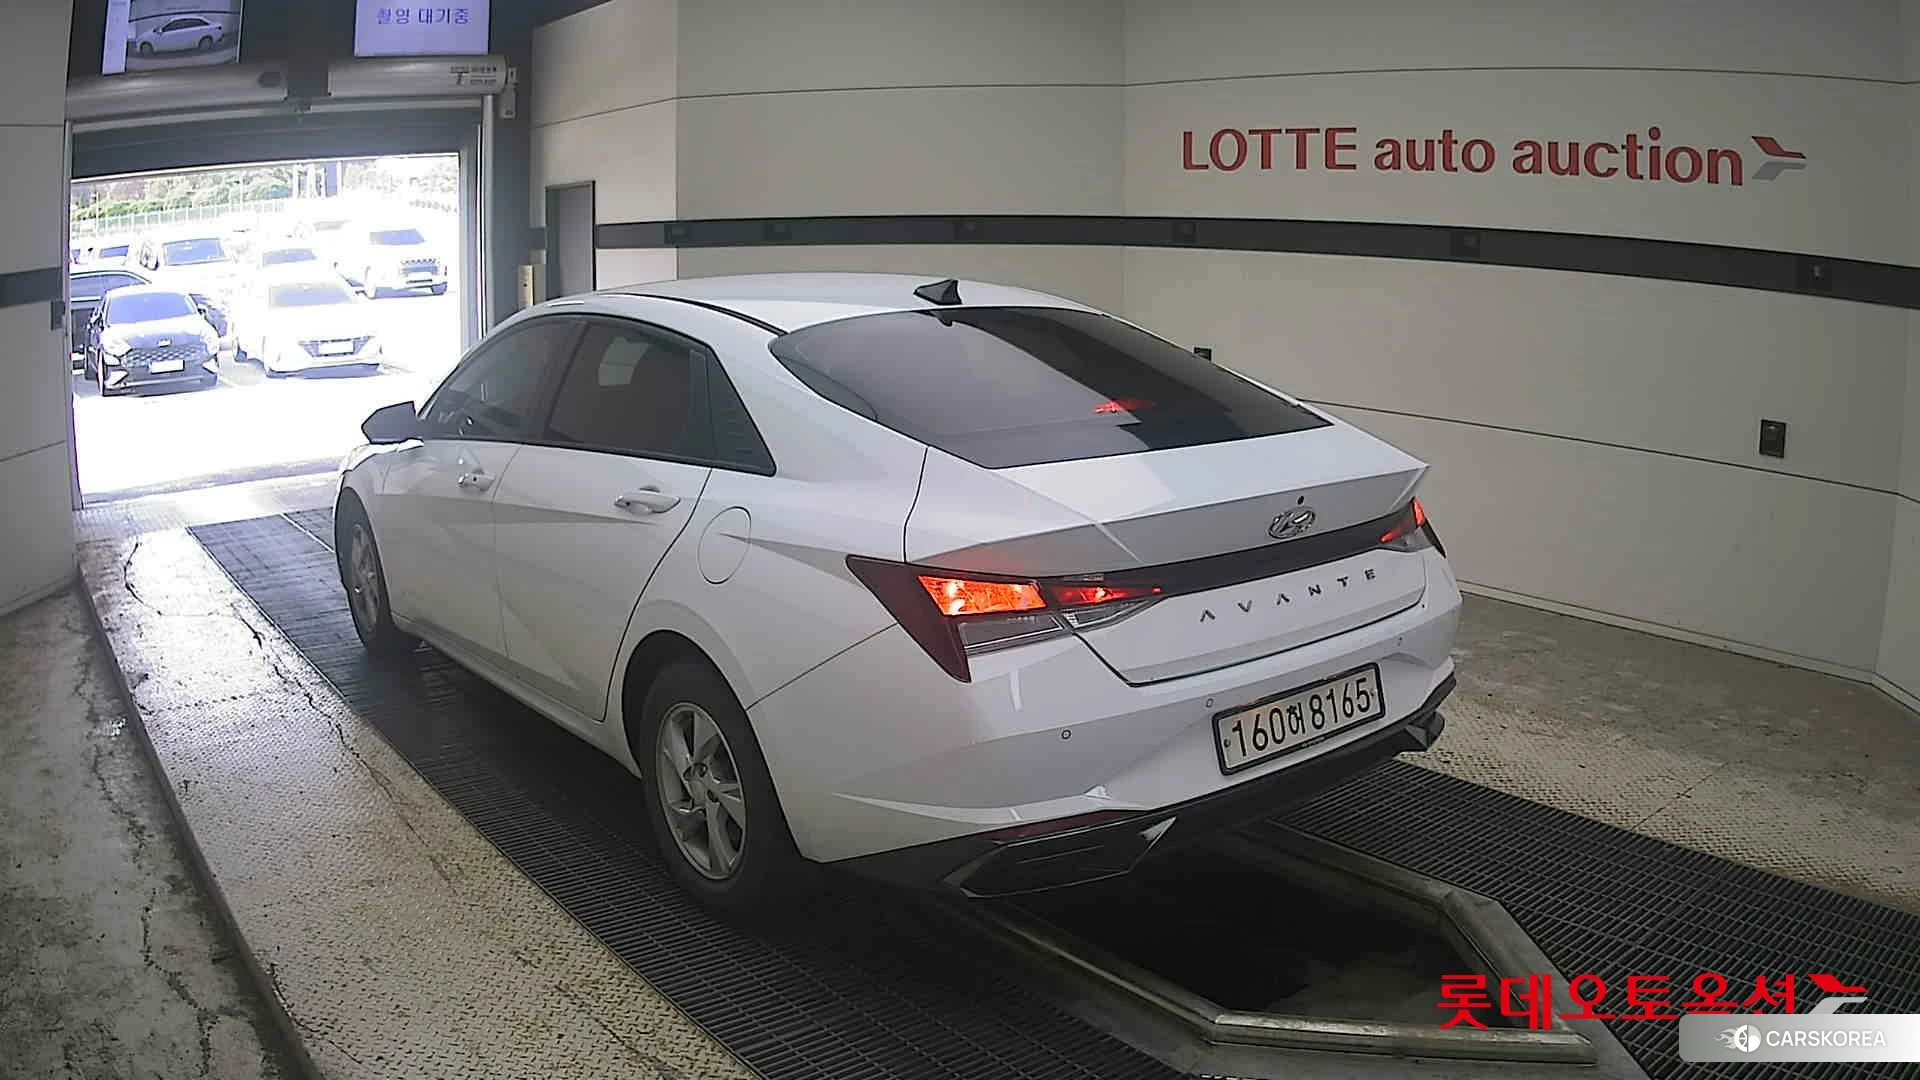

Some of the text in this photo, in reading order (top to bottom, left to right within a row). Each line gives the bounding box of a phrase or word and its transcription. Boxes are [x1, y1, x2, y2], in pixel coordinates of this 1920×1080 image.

[418, 8, 470, 25] 대기중
[1183, 126, 1744, 186] LOTTE auto auction
[1200, 568, 1377, 623] AVANTE
